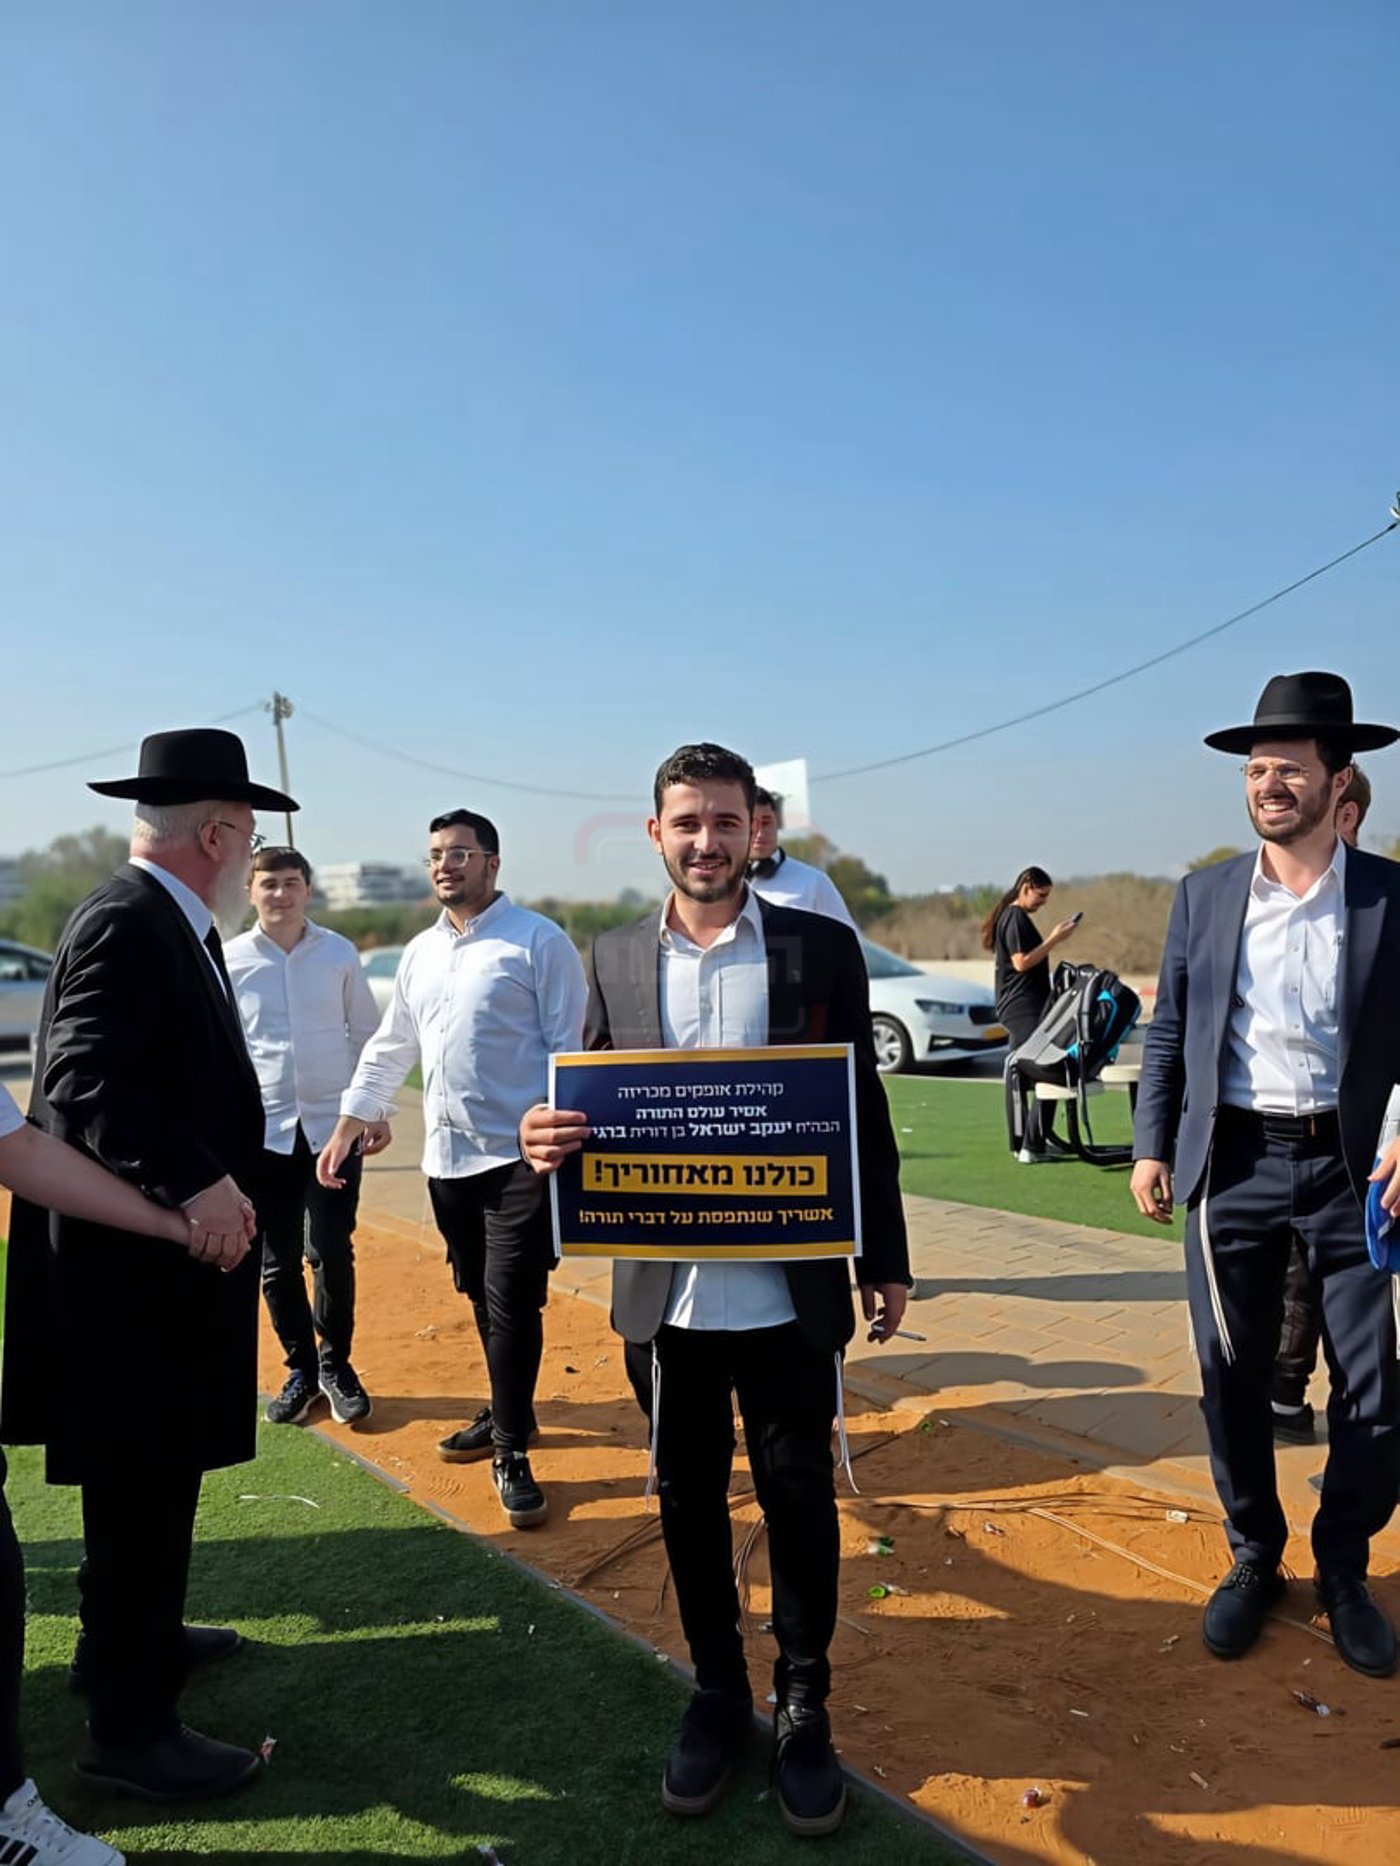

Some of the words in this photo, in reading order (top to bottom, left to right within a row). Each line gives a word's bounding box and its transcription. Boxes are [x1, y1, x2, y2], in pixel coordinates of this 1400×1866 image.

[618, 1086, 671, 1099] מכריזה
[675, 1084, 732, 1099] אופקים
[736, 1083, 784, 1098] קהילת
[636, 1107, 684, 1120] התורה
[687, 1106, 725, 1119] עולם
[729, 1105, 768, 1118] אסיר
[592, 1125, 627, 1140] ברגי
[630, 1126, 668, 1139] דורית
[671, 1126, 686, 1140] בן
[688, 1122, 746, 1137] ישראל
[749, 1121, 793, 1138] יעקב
[595, 1159, 734, 1188] מאחוריך!
[743, 1163, 815, 1187] כולנו
[579, 1209, 625, 1224] תורה!
[628, 1211, 666, 1224] דברי
[670, 1210, 693, 1224] על
[697, 1210, 774, 1224] שנתפסת
[777, 1208, 834, 1225] אשריך
